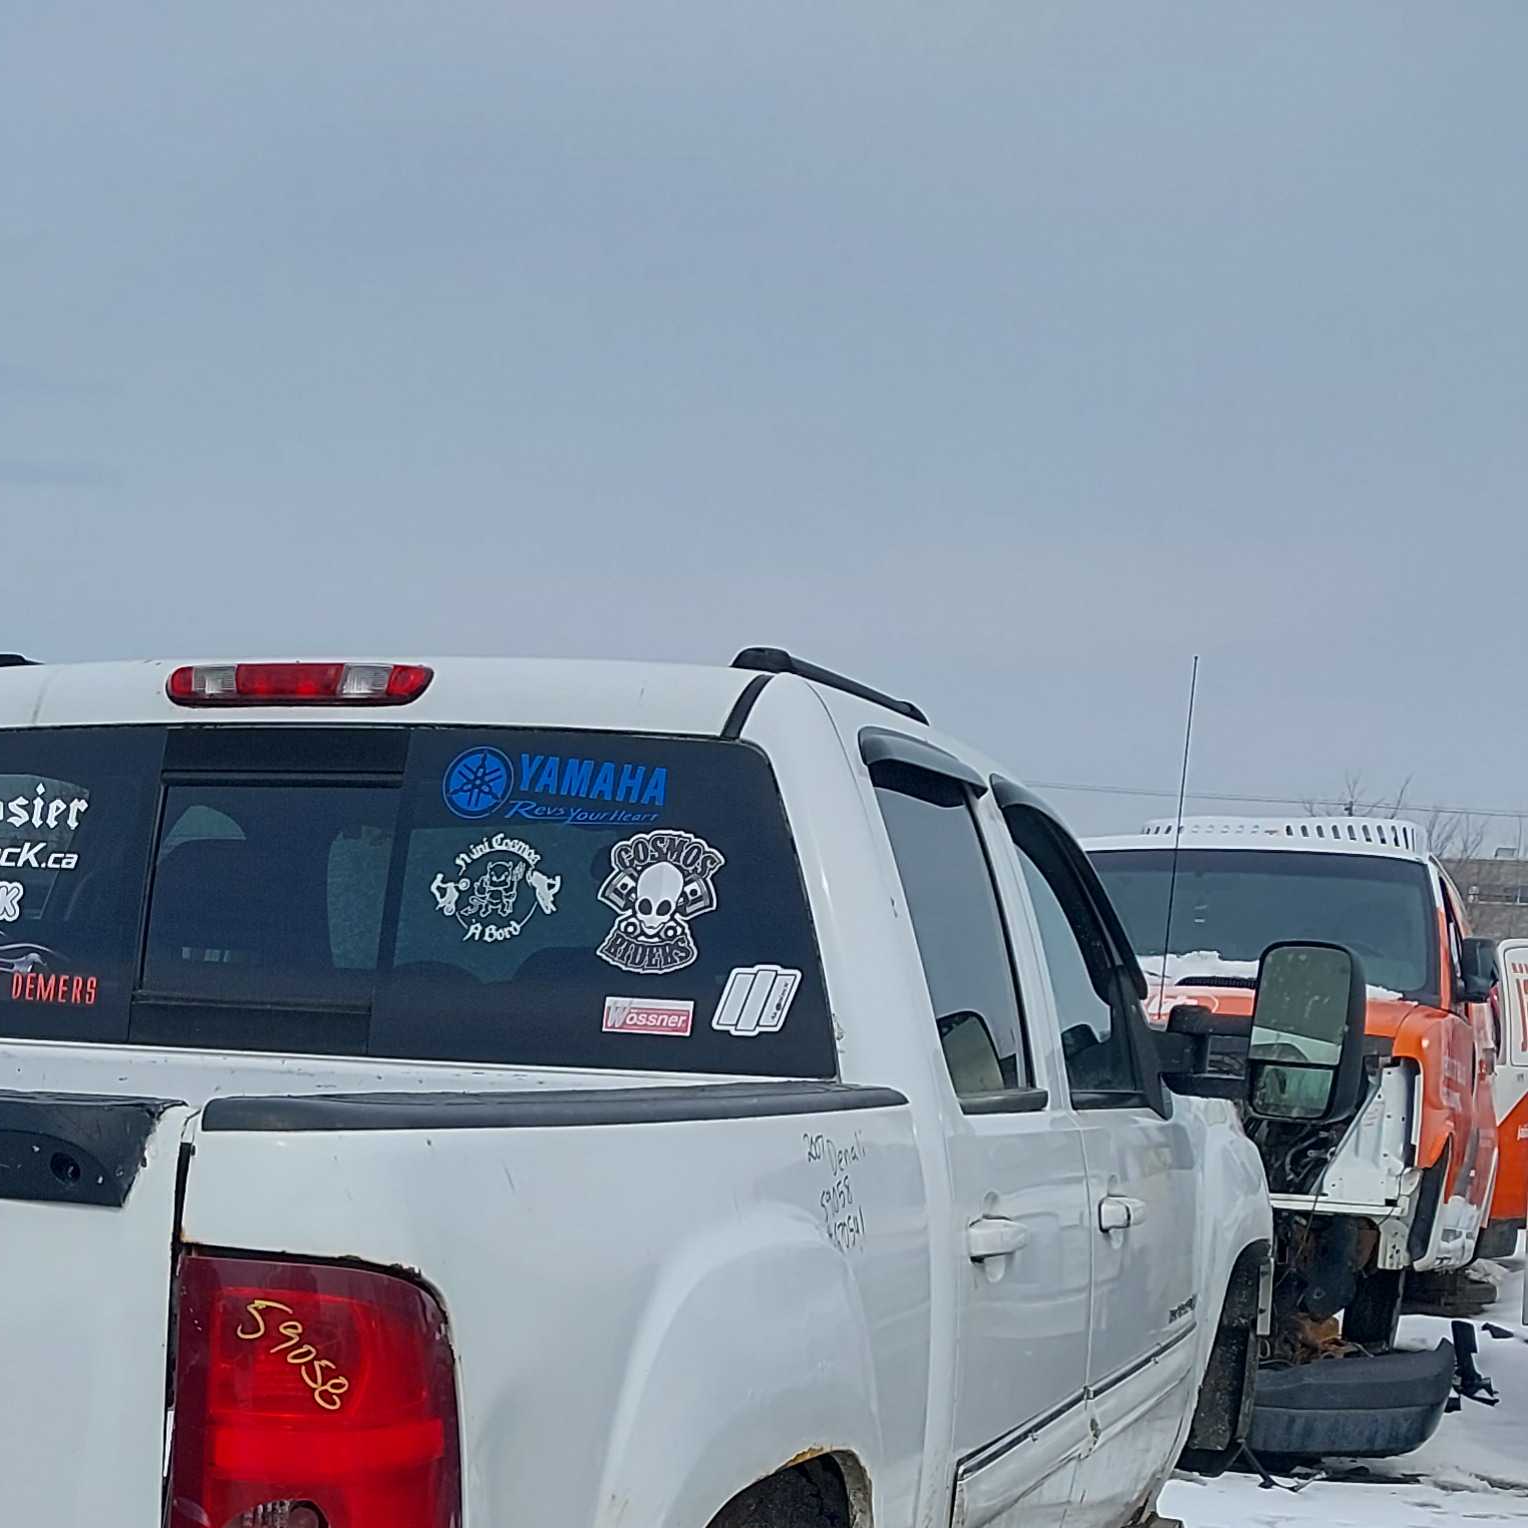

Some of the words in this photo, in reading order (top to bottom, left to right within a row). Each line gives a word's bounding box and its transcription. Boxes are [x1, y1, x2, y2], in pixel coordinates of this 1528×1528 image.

[520, 754, 668, 807] YAMAHA
[614, 835, 721, 878] COSMOS
[12, 972, 98, 1004] DEMERS
[236, 1299, 349, 1410] 59058
